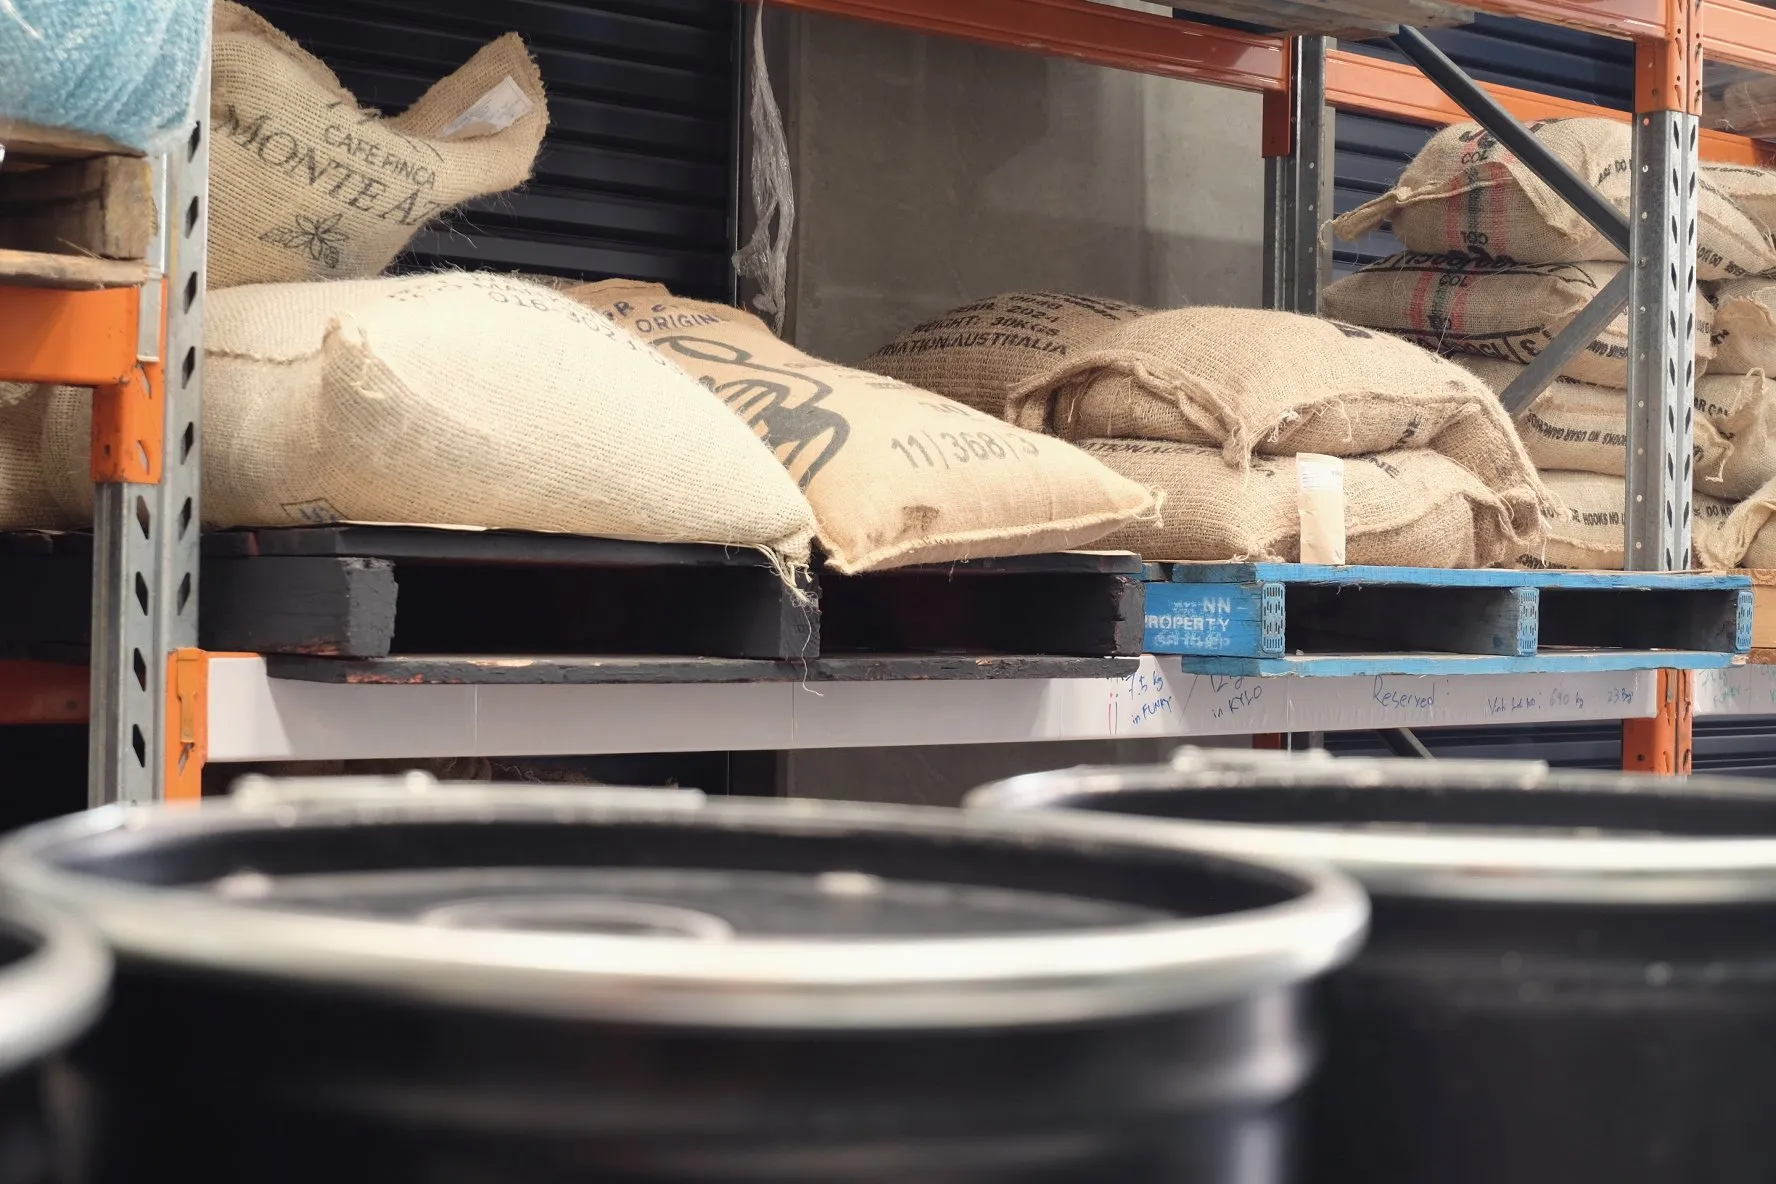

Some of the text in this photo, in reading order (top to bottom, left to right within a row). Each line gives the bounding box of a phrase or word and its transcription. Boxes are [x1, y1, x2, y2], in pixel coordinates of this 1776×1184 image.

[382, 152, 436, 190] FINCA
[1582, 511, 1608, 526] HOOKS
[1608, 511, 1619, 526] NO
